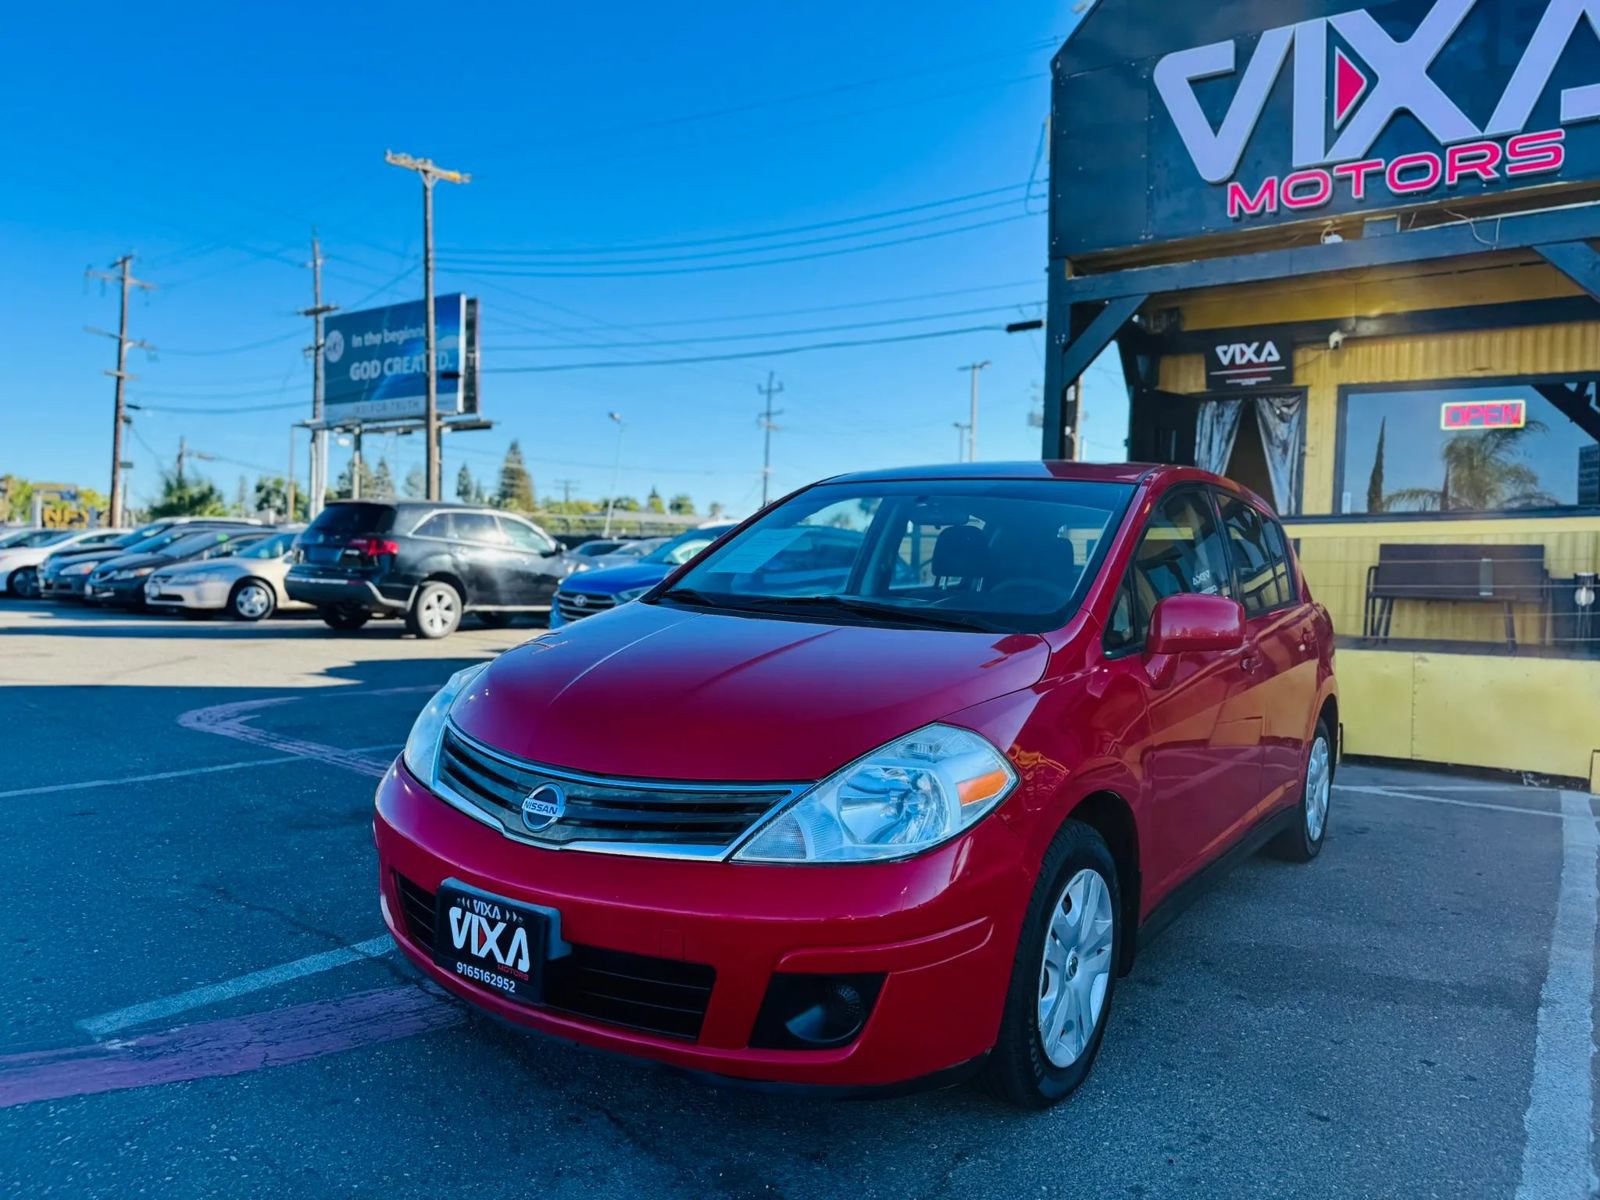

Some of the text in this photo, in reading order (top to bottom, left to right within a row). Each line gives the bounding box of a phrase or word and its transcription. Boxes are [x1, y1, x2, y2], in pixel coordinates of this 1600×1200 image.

[1227, 128, 1566, 218] MOTORS
[351, 335, 363, 347] In
[364, 331, 382, 346] the
[1215, 340, 1281, 366] VIXA
[349, 360, 381, 381] GOD
[1444, 403, 1522, 427] OPEN
[525, 800, 559, 815] NISSAN
[473, 899, 501, 920] VIXA
[449, 906, 530, 973] VIXA
[456, 961, 516, 993] 9165162952
